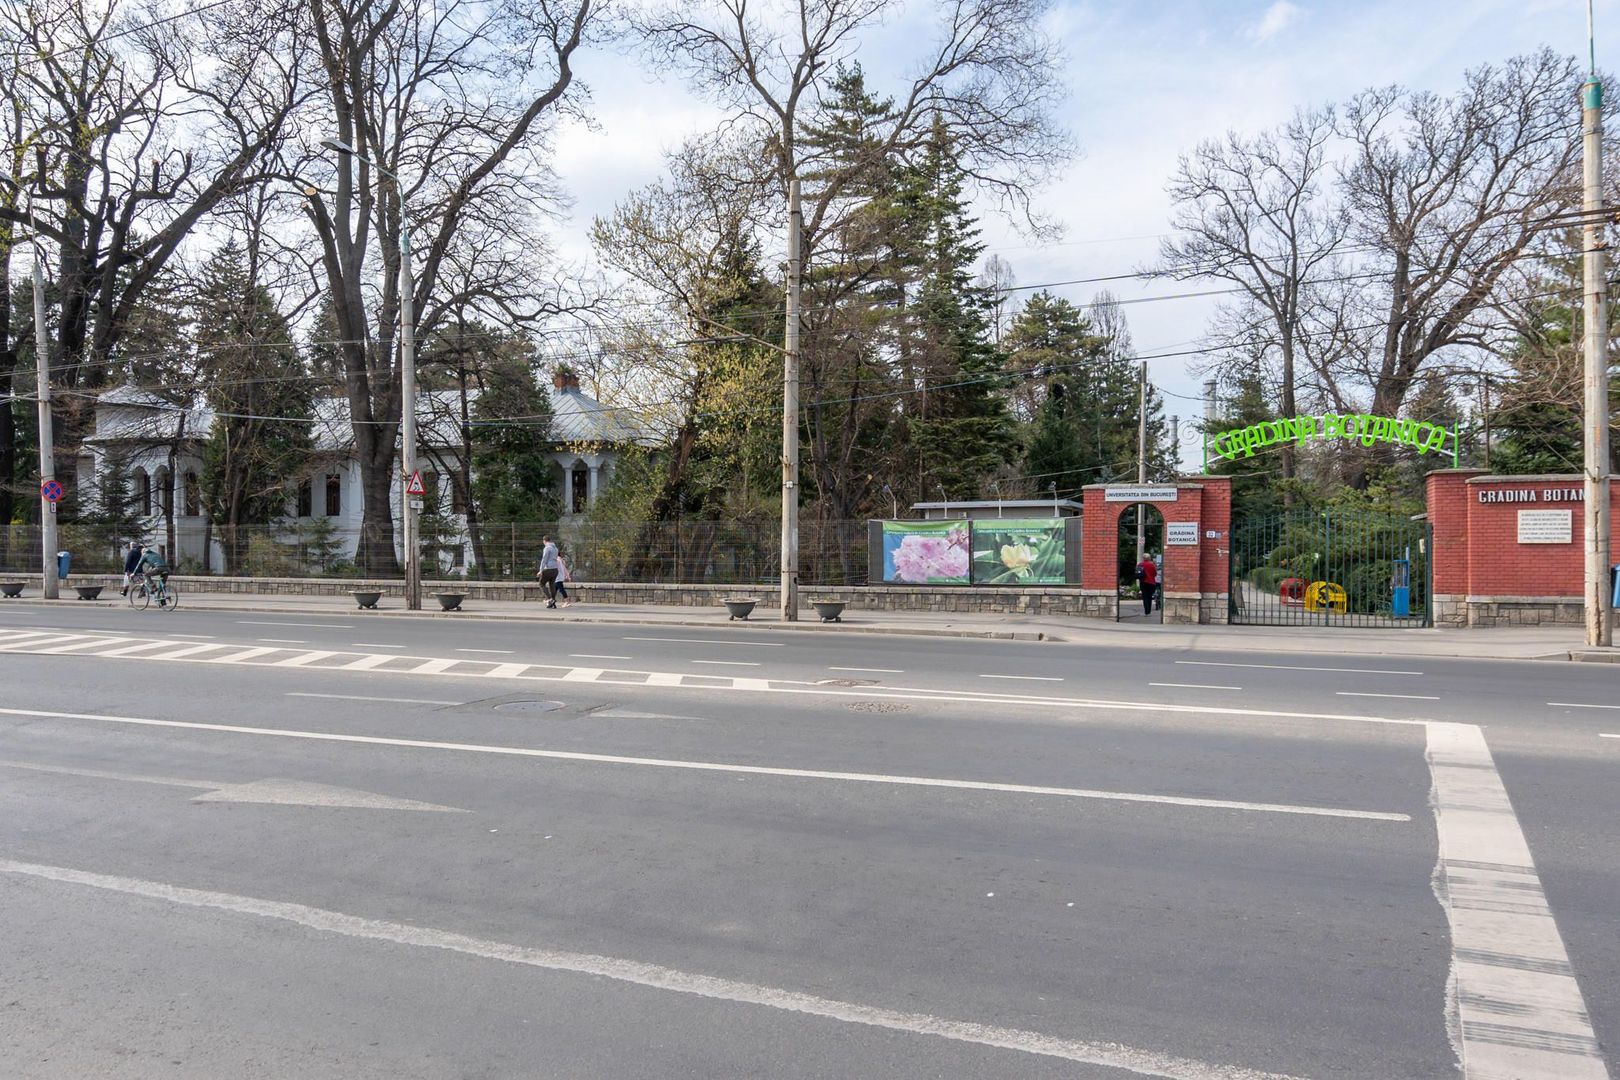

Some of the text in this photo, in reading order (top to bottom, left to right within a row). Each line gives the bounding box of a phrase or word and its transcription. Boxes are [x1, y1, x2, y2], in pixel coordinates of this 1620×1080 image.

[1214, 413, 1446, 460] GRADINA BOTANICA
[1479, 489, 1585, 502] GRADINA BOTAN
